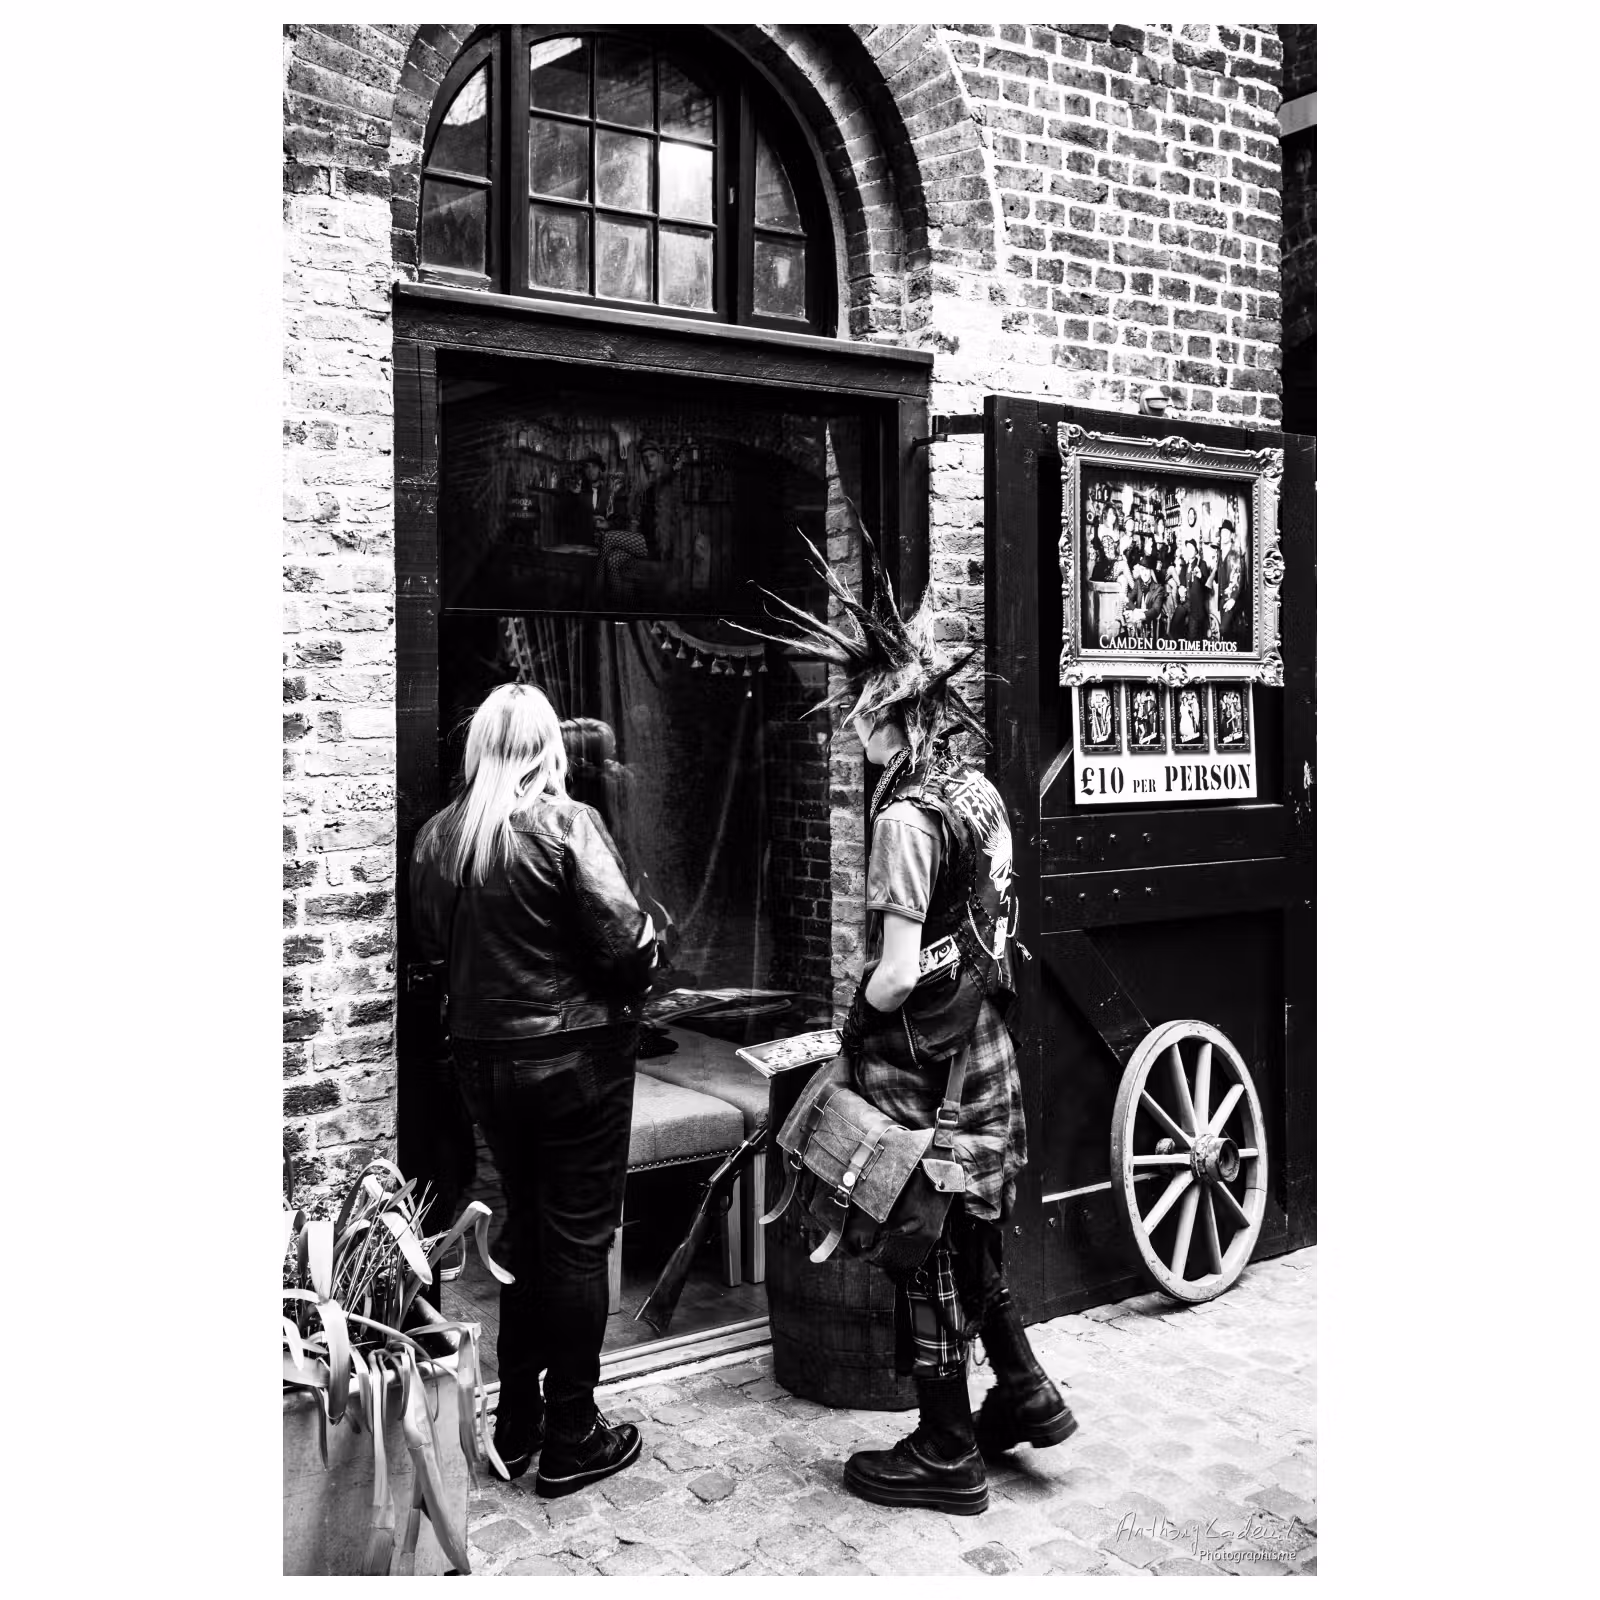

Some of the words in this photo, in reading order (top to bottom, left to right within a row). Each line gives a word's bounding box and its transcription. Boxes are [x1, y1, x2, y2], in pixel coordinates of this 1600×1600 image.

[1099, 634, 1153, 649] CAMDEN
[1156, 638, 1177, 650] OLD
[1178, 638, 1200, 651] TIME
[1202, 639, 1237, 652] PHOTOS
[1081, 766, 1124, 795] £10
[1133, 779, 1156, 793] PER
[1164, 764, 1250, 791] PERSON
